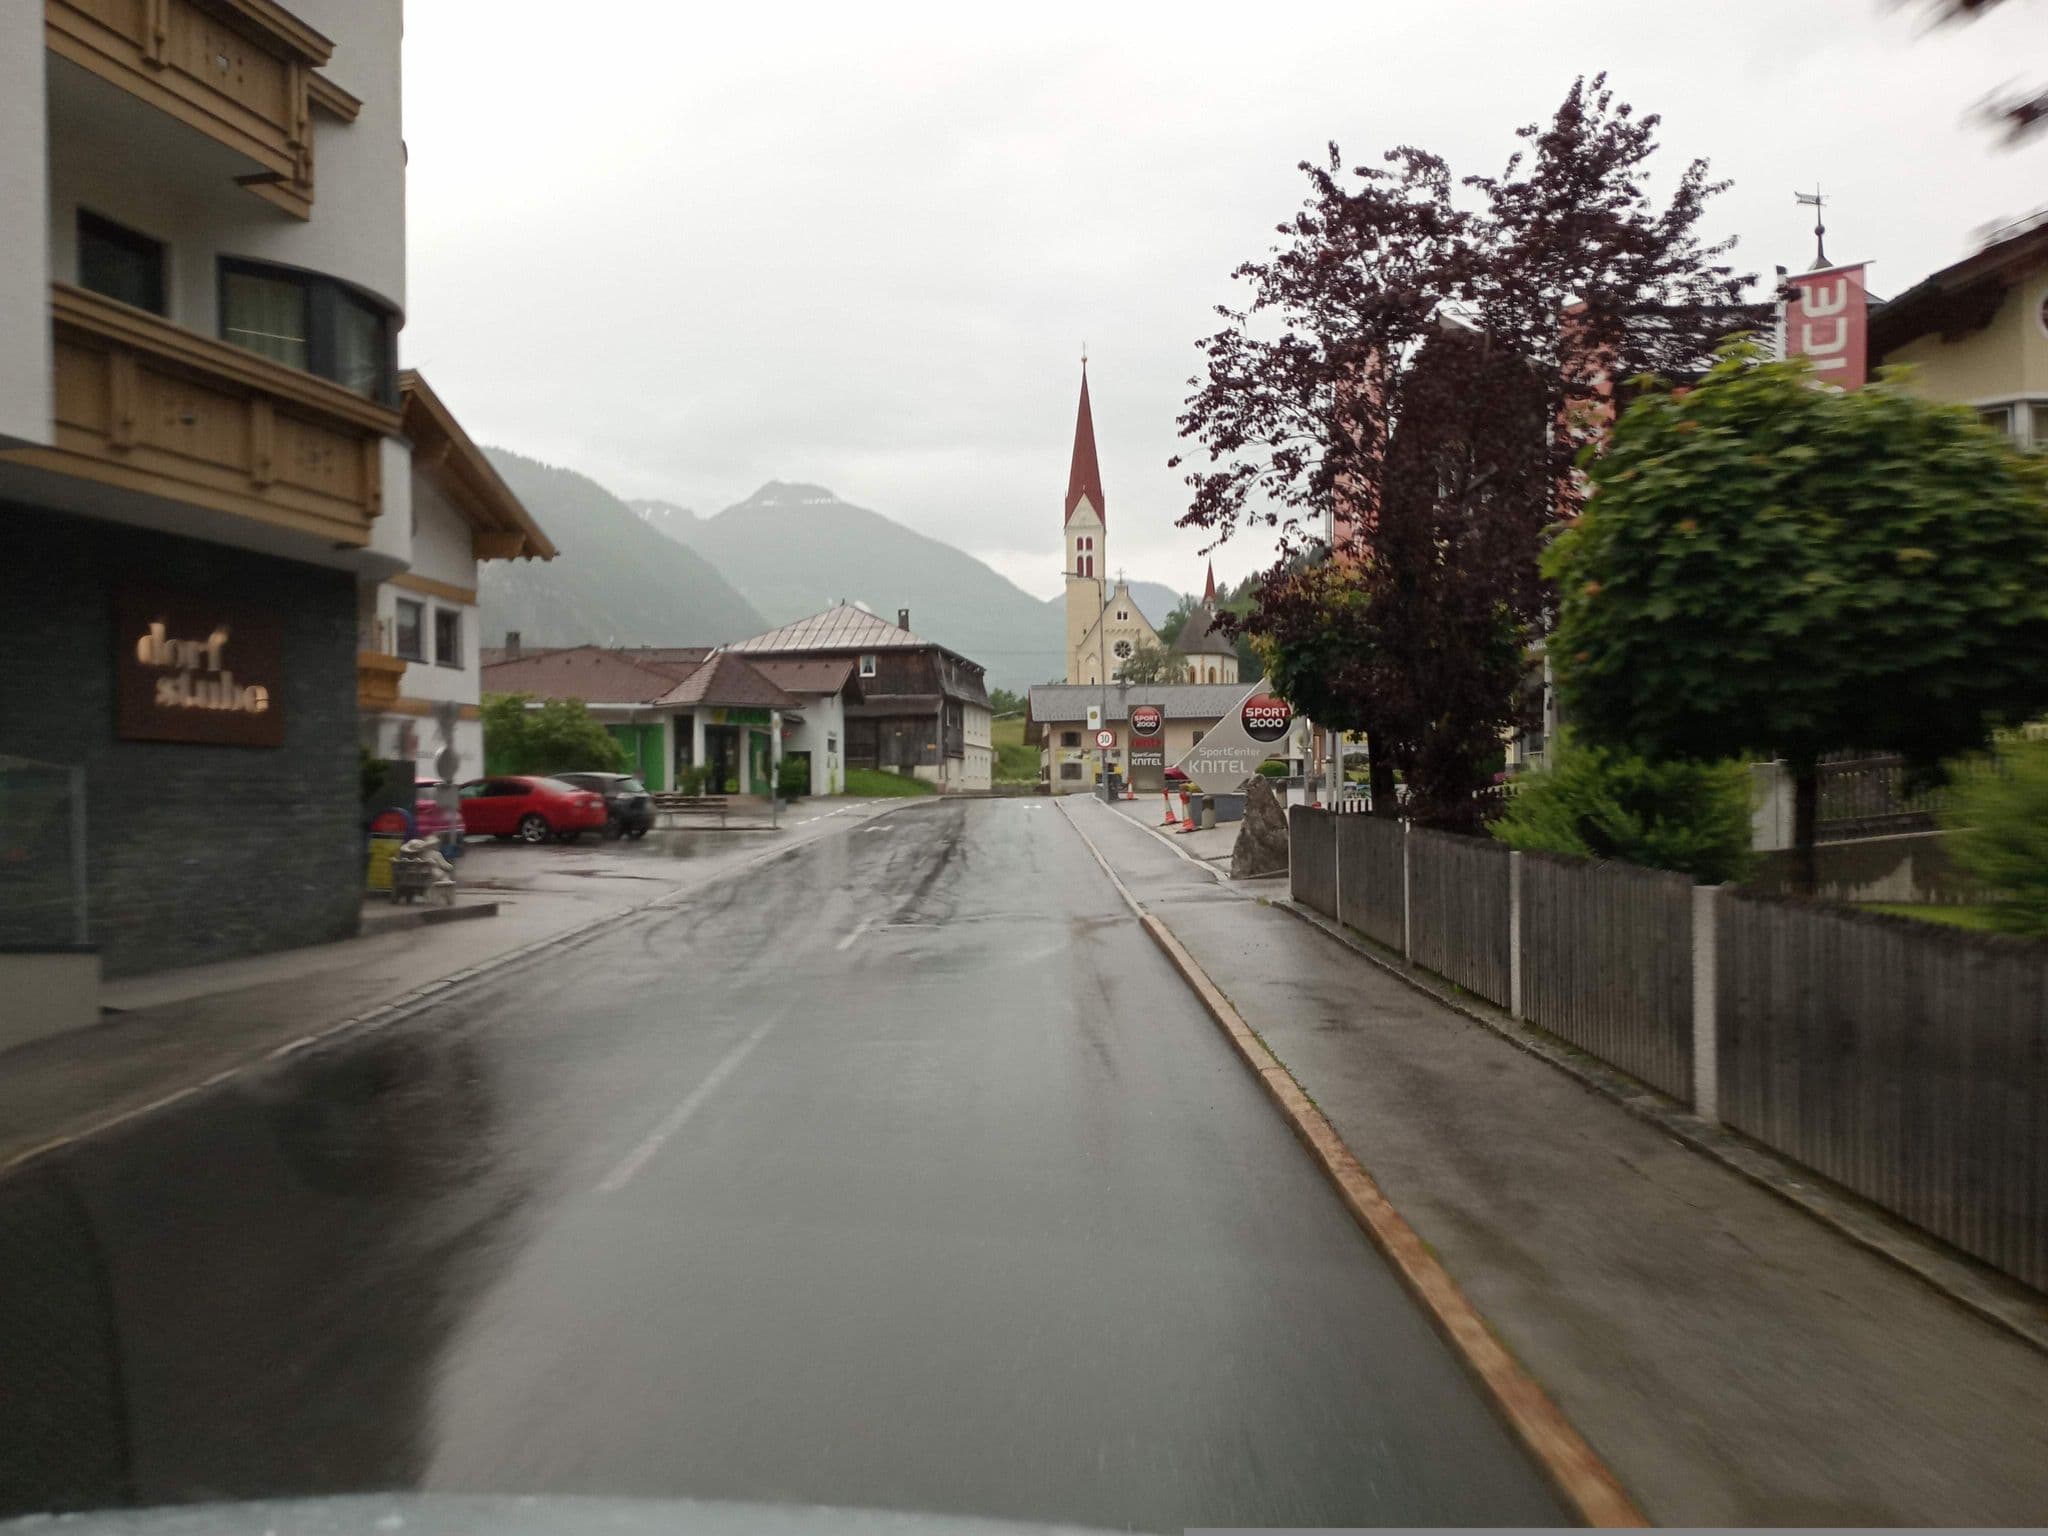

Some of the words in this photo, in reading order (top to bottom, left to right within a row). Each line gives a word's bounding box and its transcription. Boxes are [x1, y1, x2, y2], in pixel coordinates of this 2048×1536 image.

[1134, 714, 1158, 722] SPORT
[1245, 707, 1288, 718] SPORT
[1249, 718, 1284, 729] 2000
[1100, 734, 1110, 744] 30
[1199, 746, 1260, 759] SportCenter
[1188, 759, 1249, 775] KNITEL
